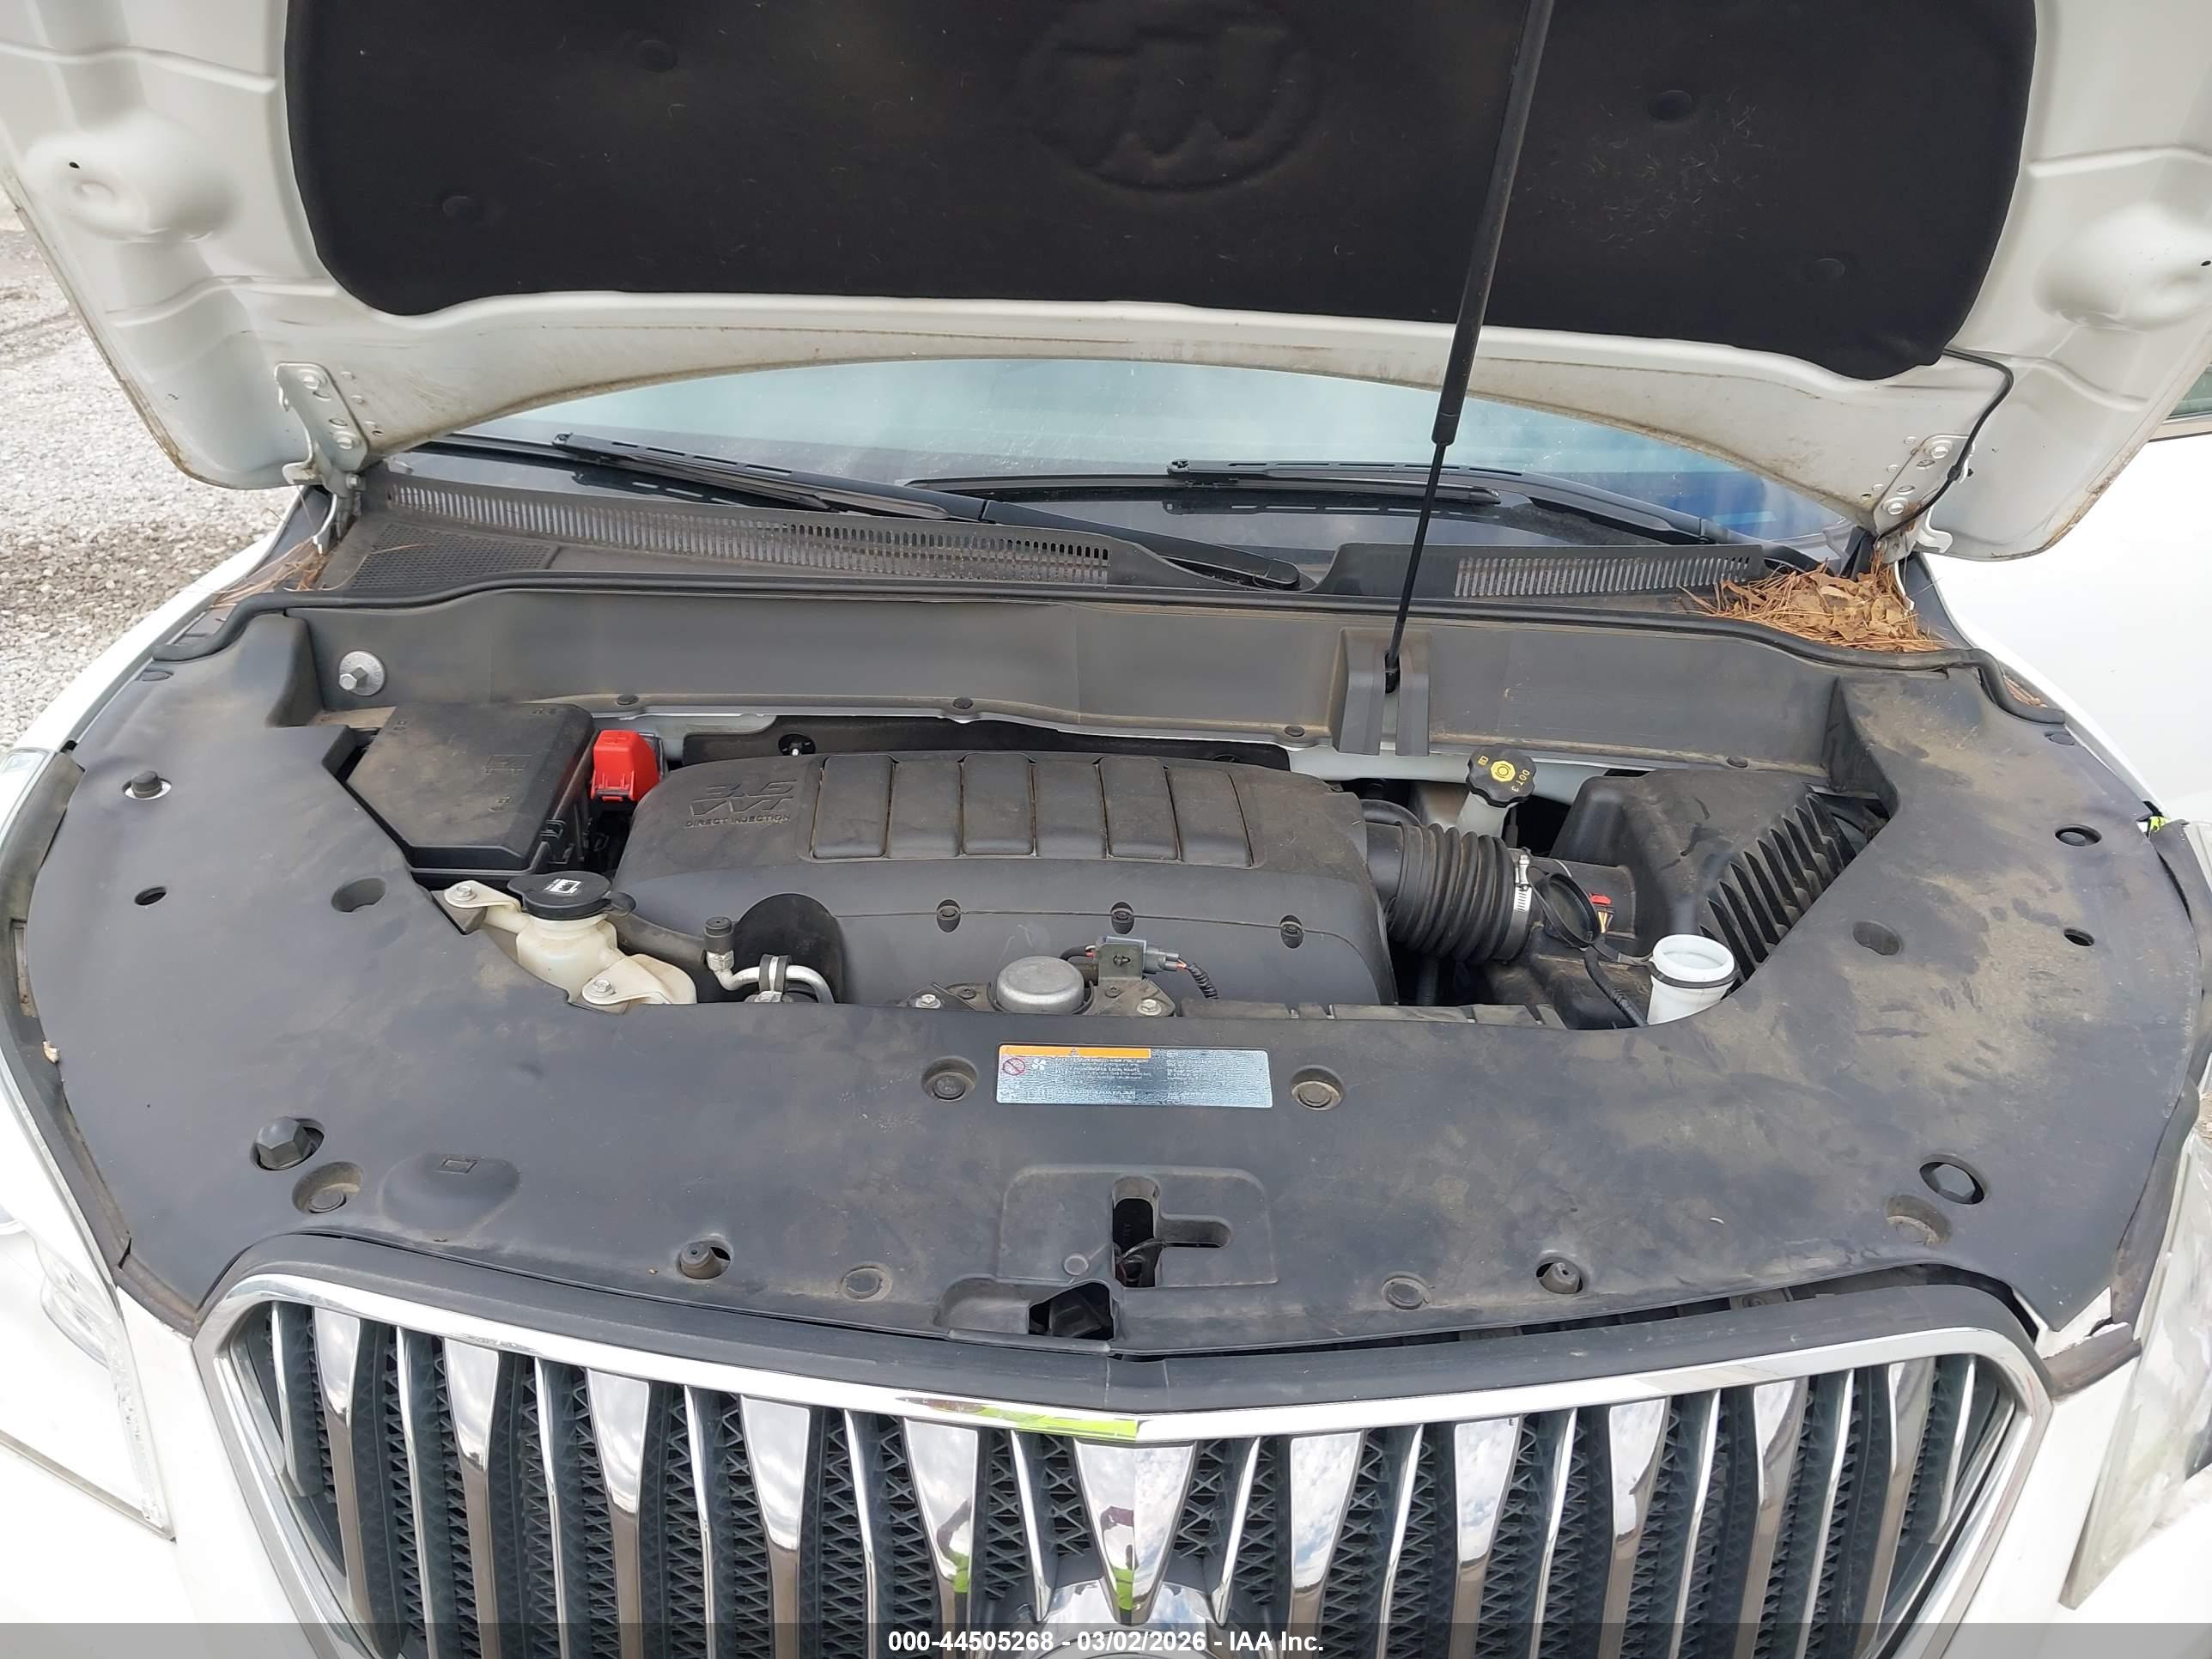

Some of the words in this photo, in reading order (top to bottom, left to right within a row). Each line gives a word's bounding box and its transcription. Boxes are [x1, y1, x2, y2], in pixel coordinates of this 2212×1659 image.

[1516, 769, 1530, 786] DOT
[686, 817, 728, 828] DIRECT
[731, 814, 790, 825] INJECTION
